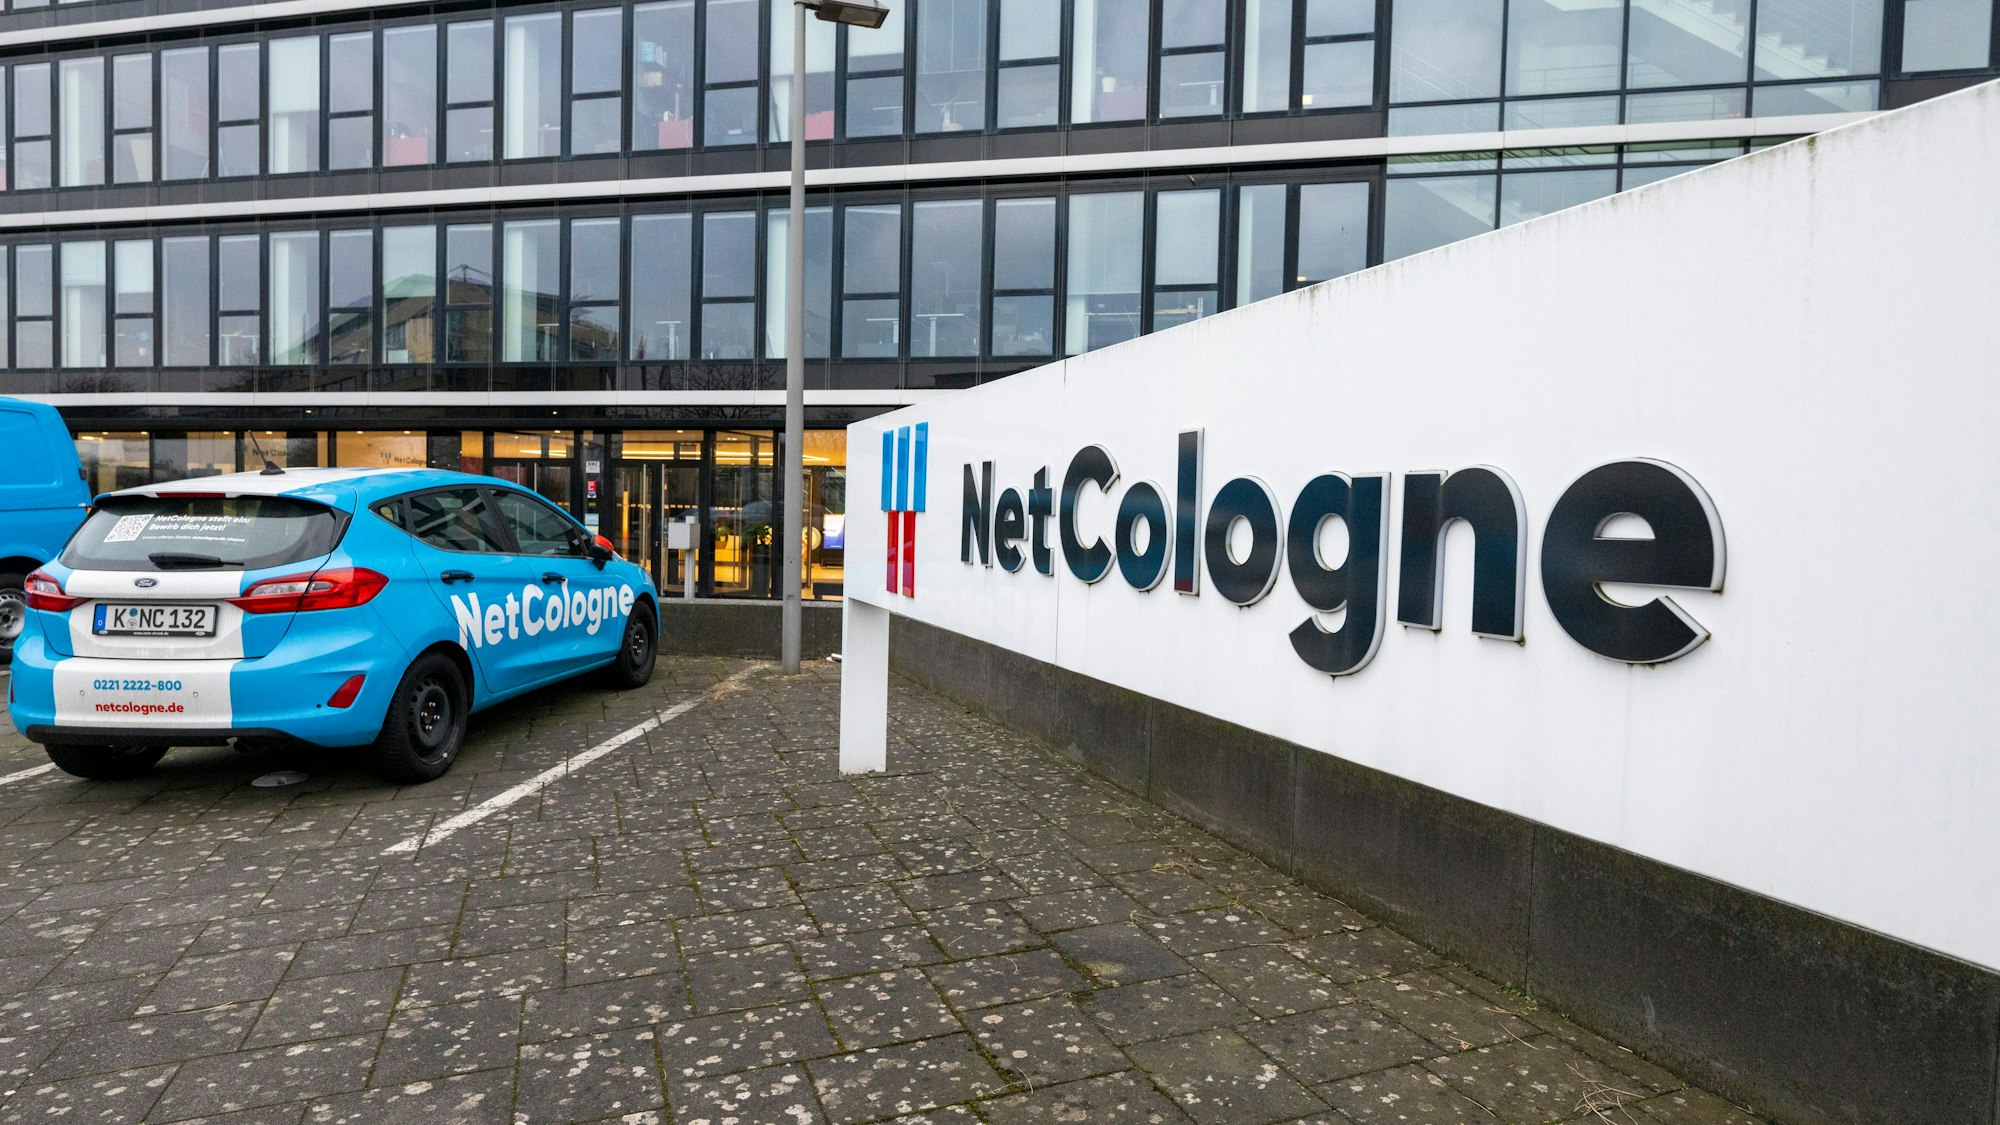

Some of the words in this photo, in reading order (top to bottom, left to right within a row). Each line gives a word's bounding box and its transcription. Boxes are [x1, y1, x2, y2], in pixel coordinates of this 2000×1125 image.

[156, 515, 208, 523] NetCologne
[200, 524, 227, 532] jetzt!
[961, 427, 1726, 676] NetCologne
[136, 579, 156, 587] Ford
[113, 608, 127, 628] K
[140, 608, 164, 628] NC
[169, 609, 206, 629] 132
[450, 578, 635, 651] NetCologne
[93, 679, 119, 690] 0221
[122, 680, 182, 691] 2222-800
[95, 701, 184, 715] netcologne.de
